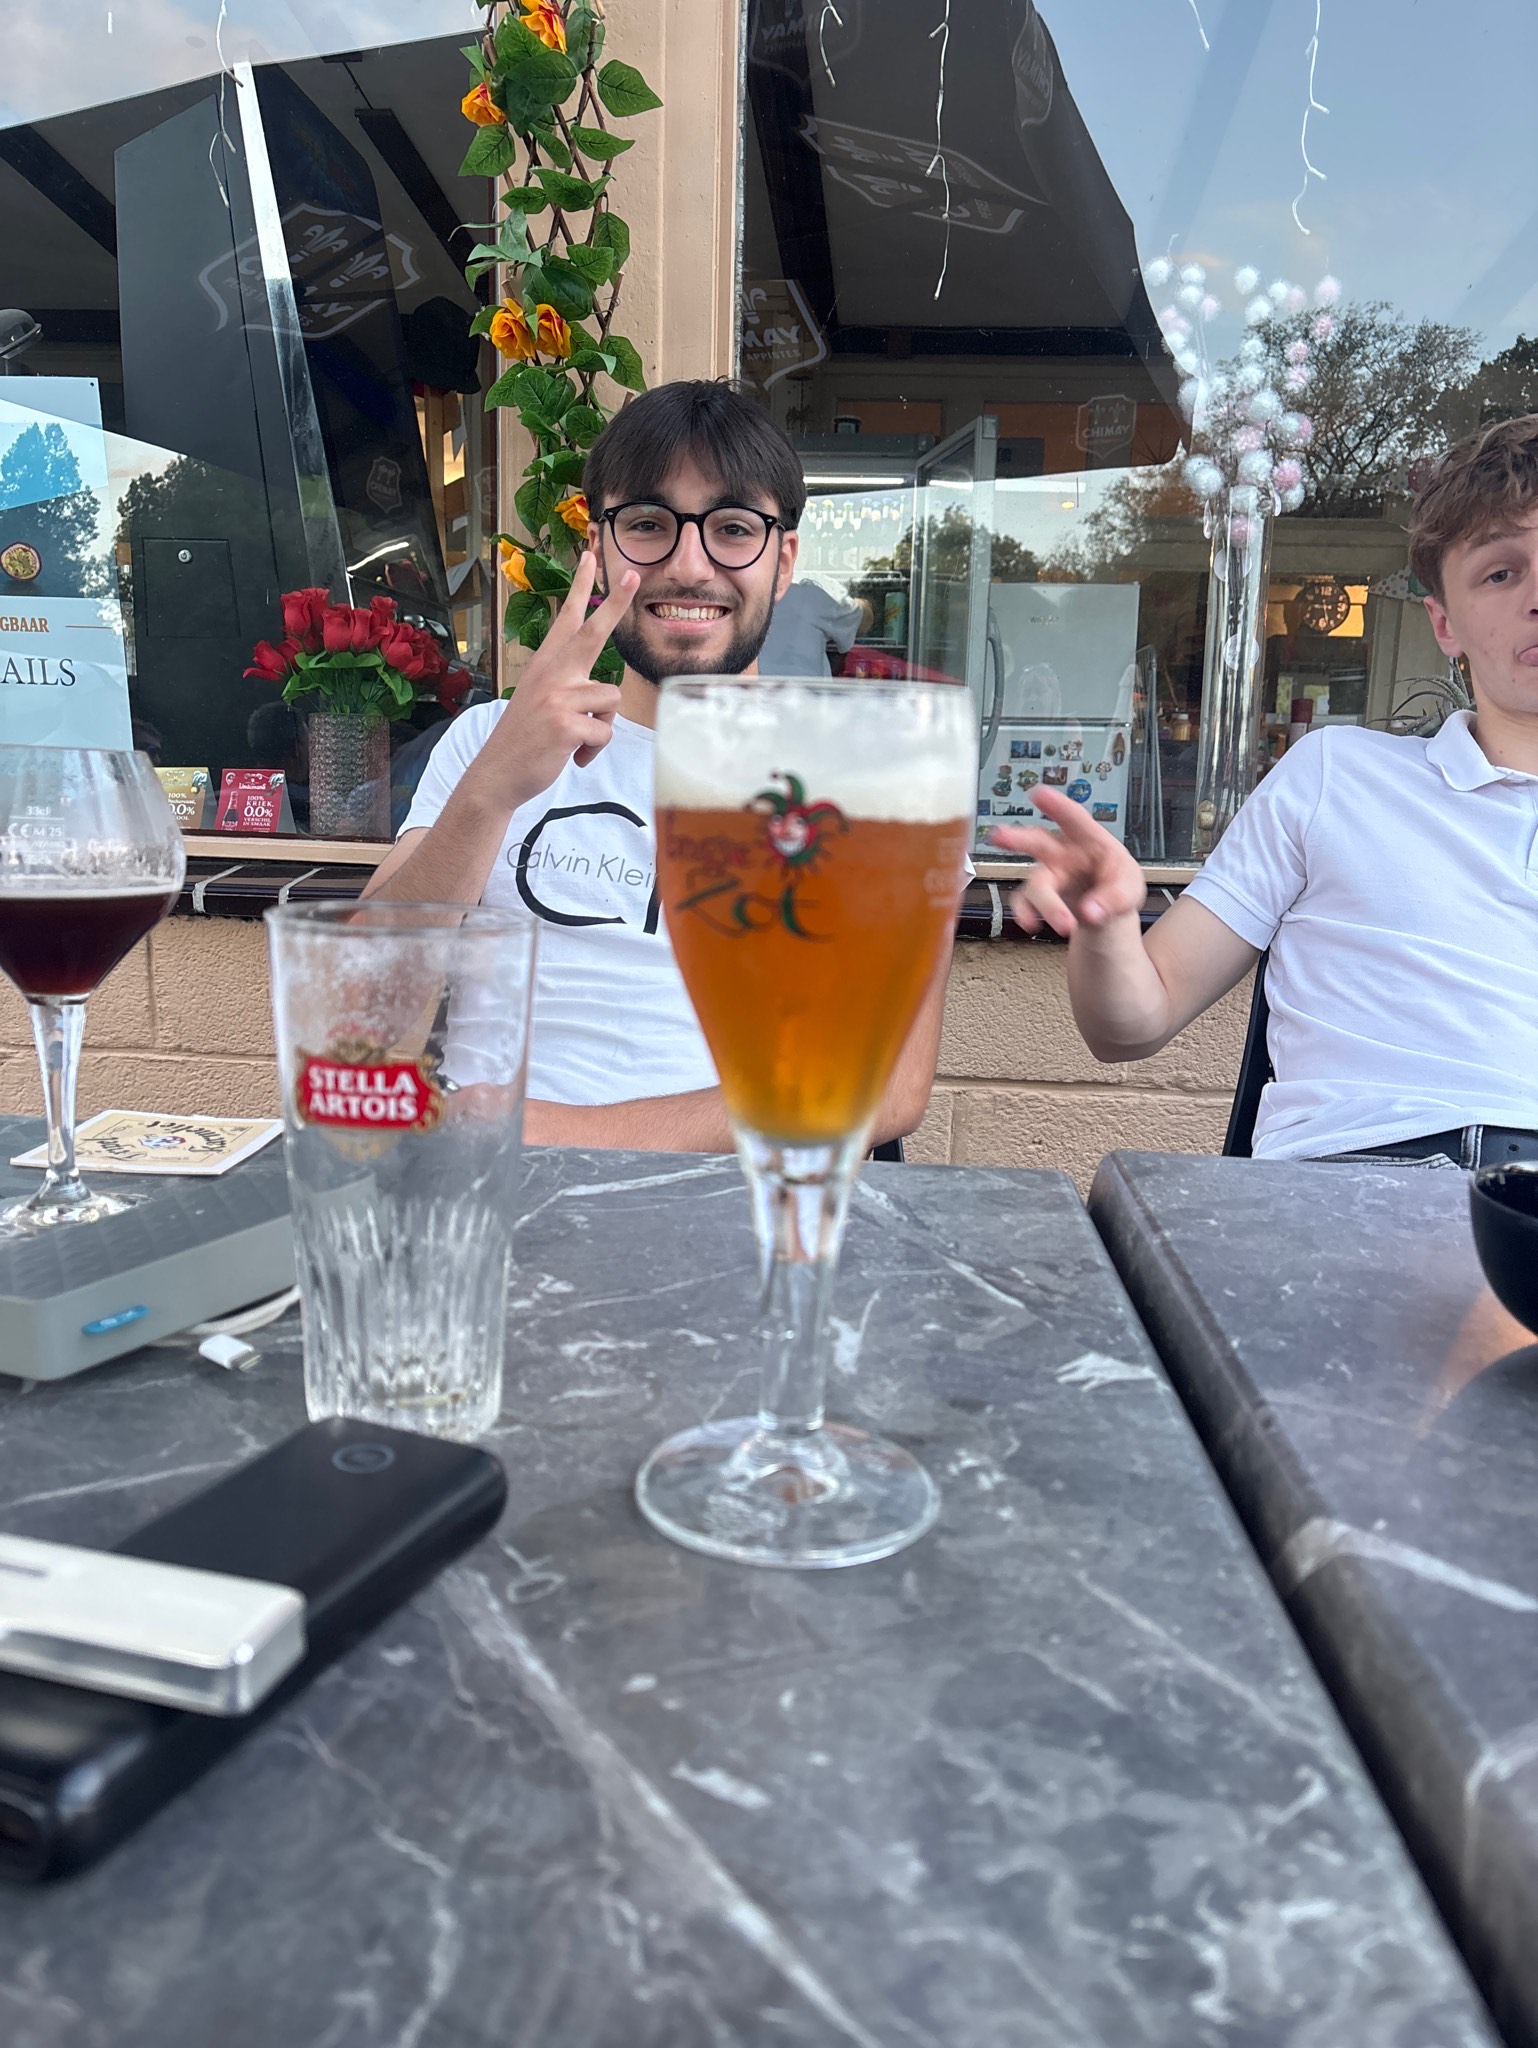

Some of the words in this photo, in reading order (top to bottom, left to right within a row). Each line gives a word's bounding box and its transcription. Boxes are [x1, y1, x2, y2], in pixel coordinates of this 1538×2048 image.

[1082, 424, 1130, 438] CHIMAY
[0, 616, 50, 633] GBAAR
[0, 656, 76, 687] AILS
[244, 805, 273, 817] 0,0%
[506, 842, 591, 876] Calvin
[308, 1065, 419, 1095] STELLA
[309, 1091, 418, 1122] ARTOIS
